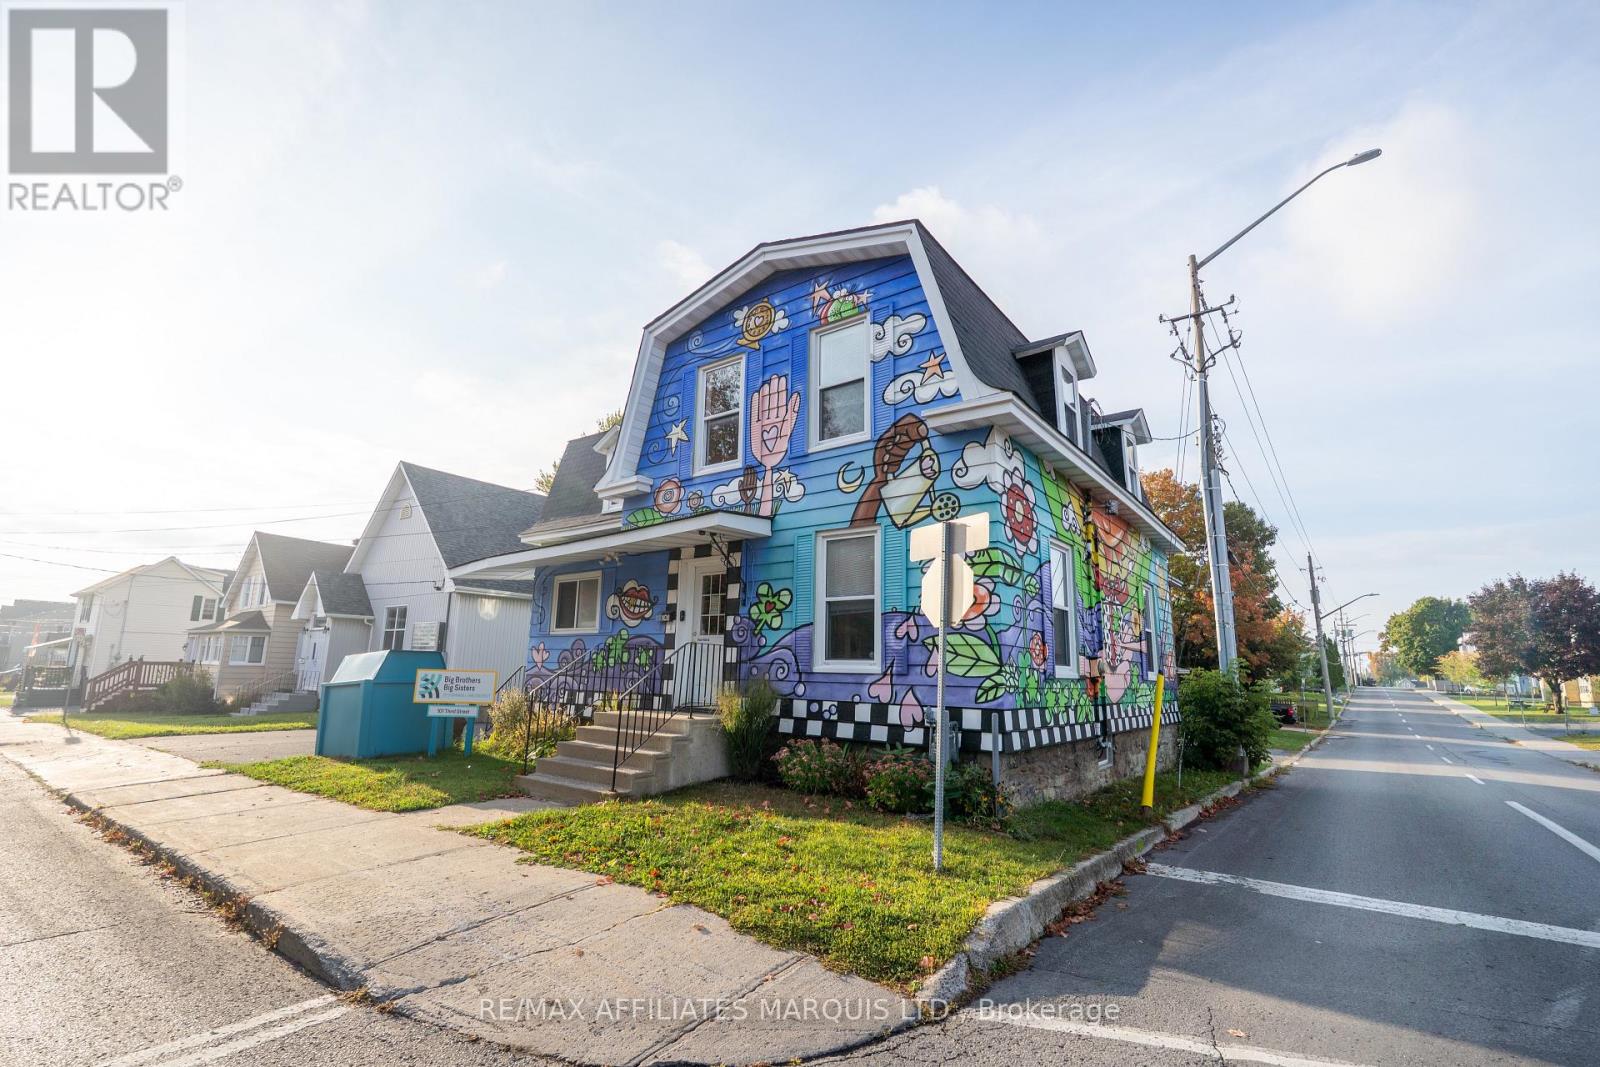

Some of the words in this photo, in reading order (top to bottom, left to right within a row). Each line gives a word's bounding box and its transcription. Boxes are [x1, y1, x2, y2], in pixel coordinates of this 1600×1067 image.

[444, 675, 454, 684] Big
[455, 676, 481, 684] Brothers
[443, 683, 453, 692] Big
